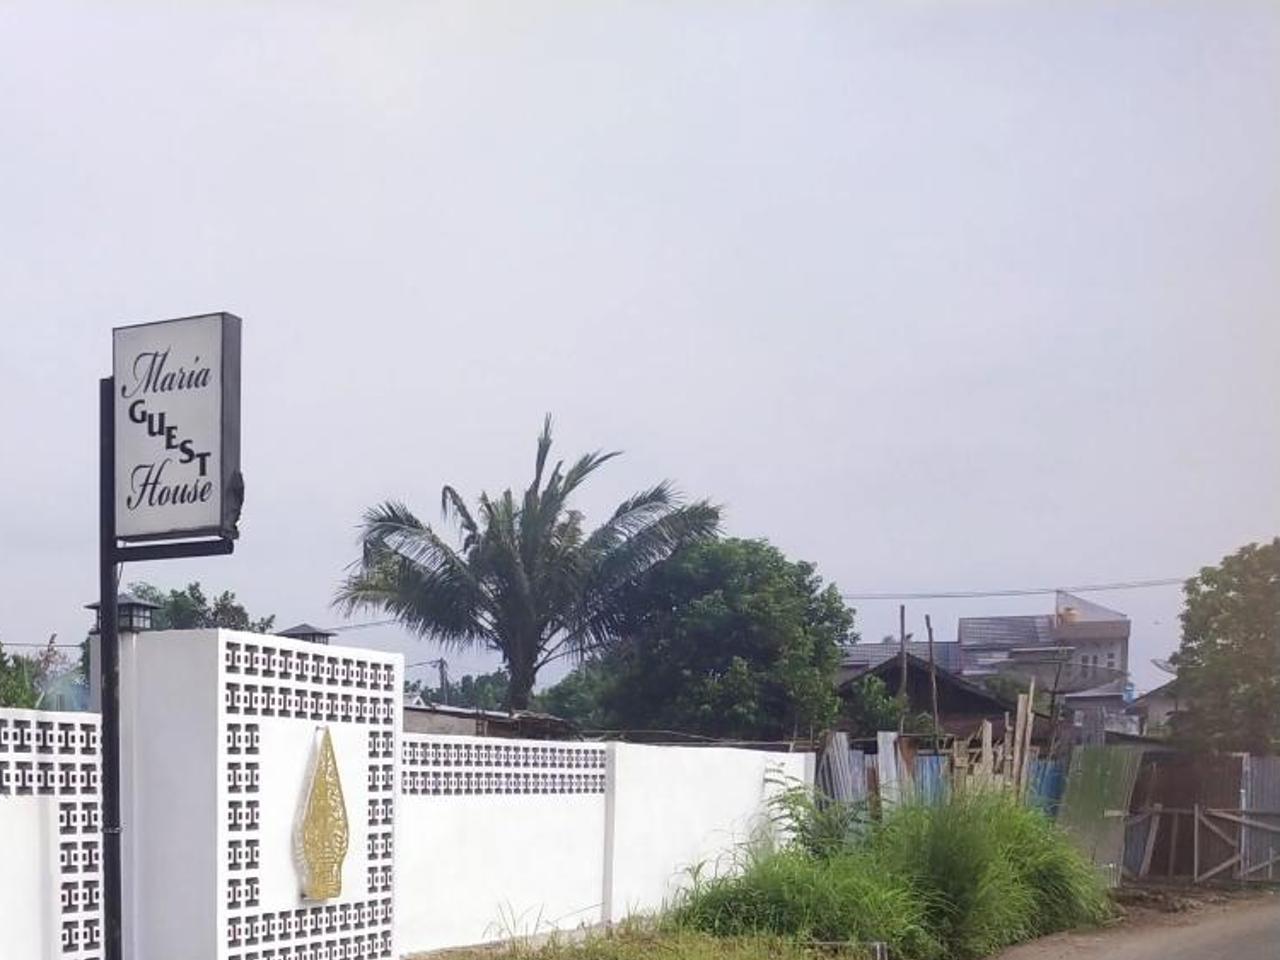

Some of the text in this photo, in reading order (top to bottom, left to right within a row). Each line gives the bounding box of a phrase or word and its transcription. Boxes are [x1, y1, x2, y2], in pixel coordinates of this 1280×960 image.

[121, 345, 211, 398] Maria
[128, 399, 211, 476] GUEST
[127, 457, 212, 510] House
